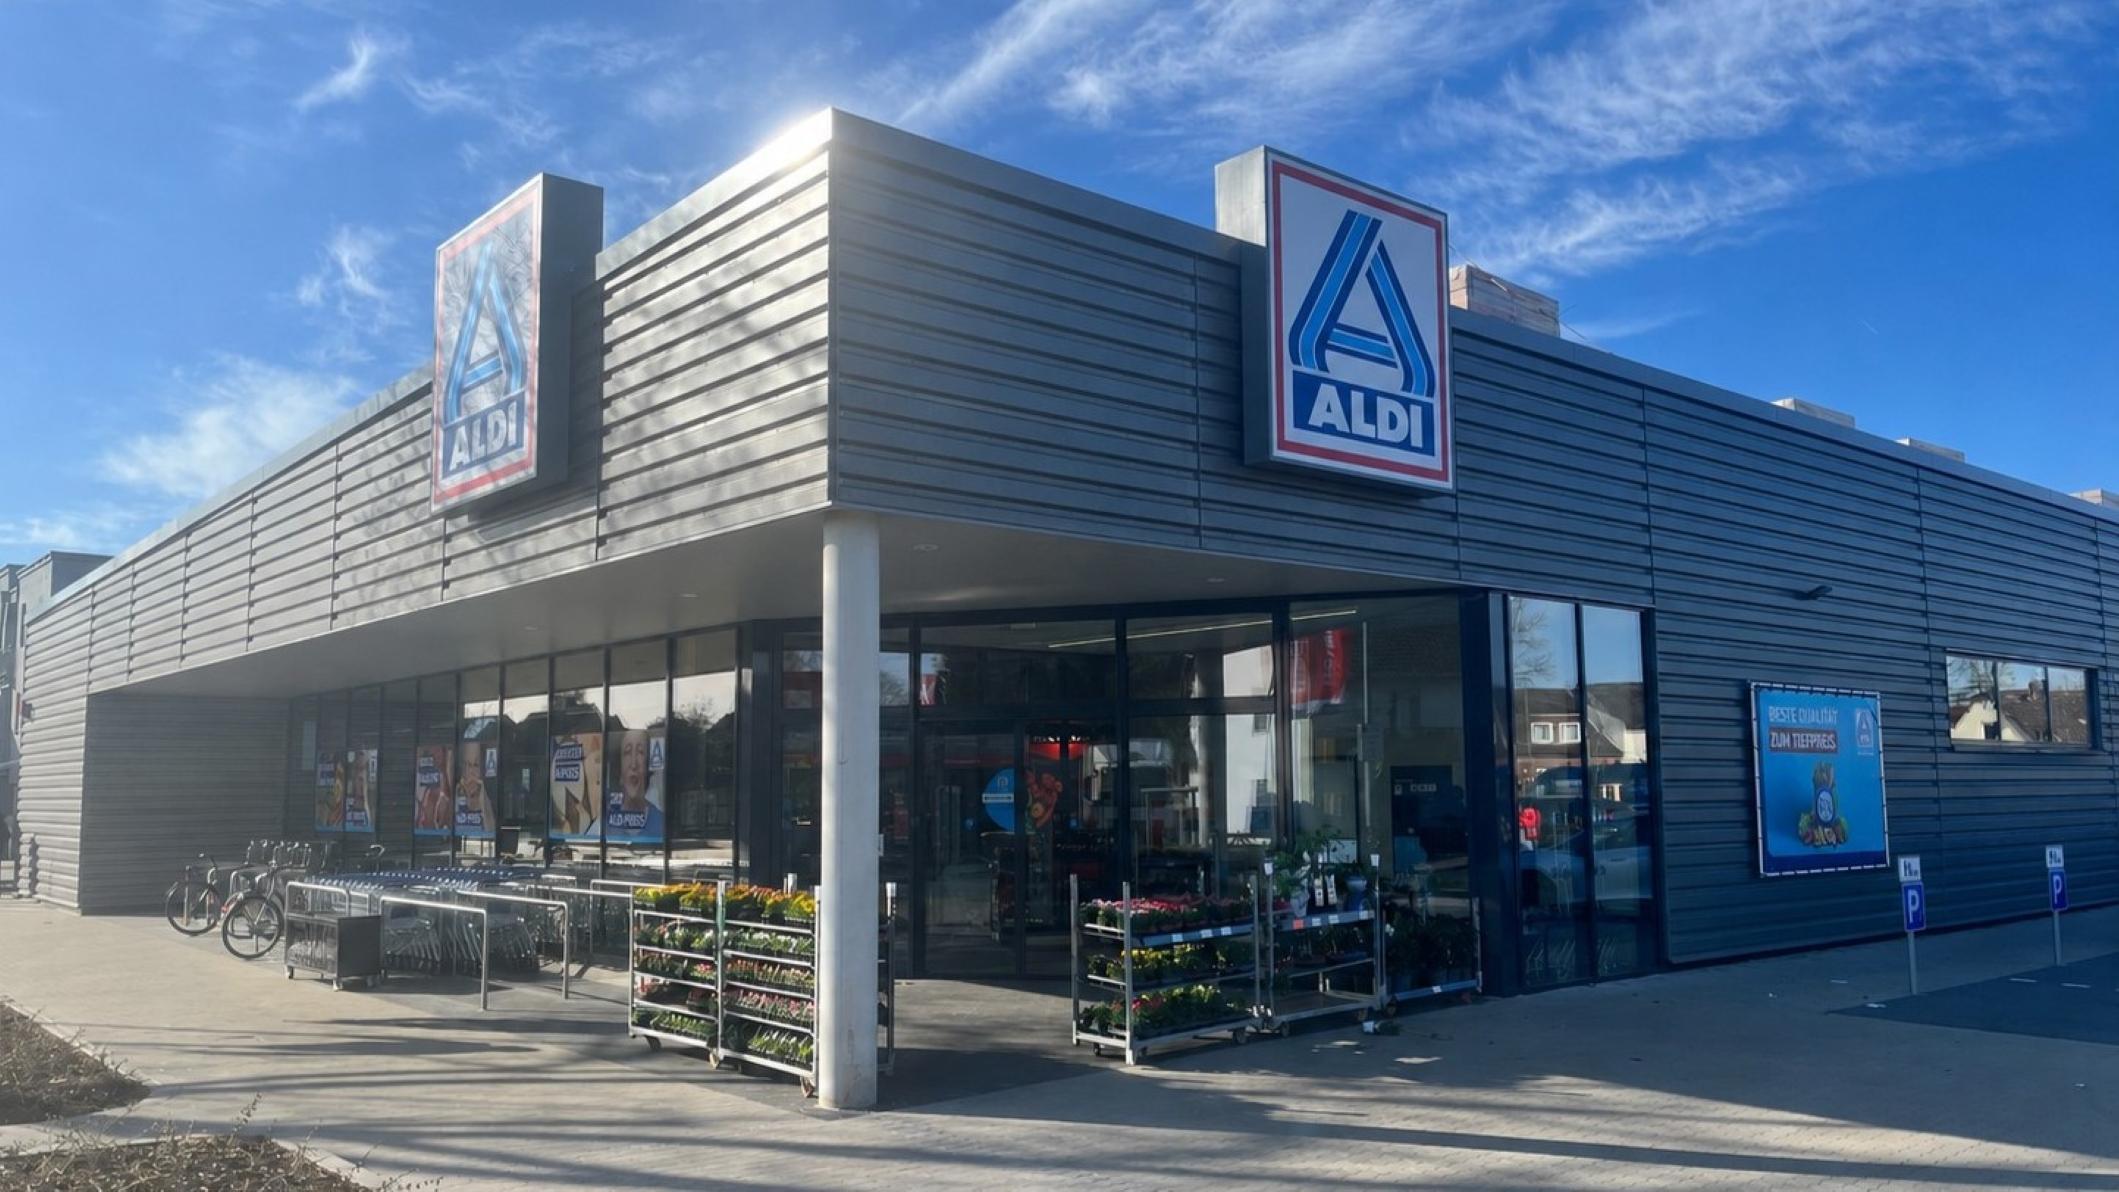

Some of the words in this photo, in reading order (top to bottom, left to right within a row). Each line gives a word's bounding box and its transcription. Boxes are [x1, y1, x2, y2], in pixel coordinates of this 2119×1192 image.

[1308, 383, 1423, 448] ALDI
[449, 401, 517, 471] ALDI
[1768, 705, 1796, 724] BESTE
[1770, 731, 1791, 748] ZUM
[1791, 732, 1836, 749] TIEFPREIS
[2053, 875, 2062, 904] P
[1908, 889, 1920, 923] P
